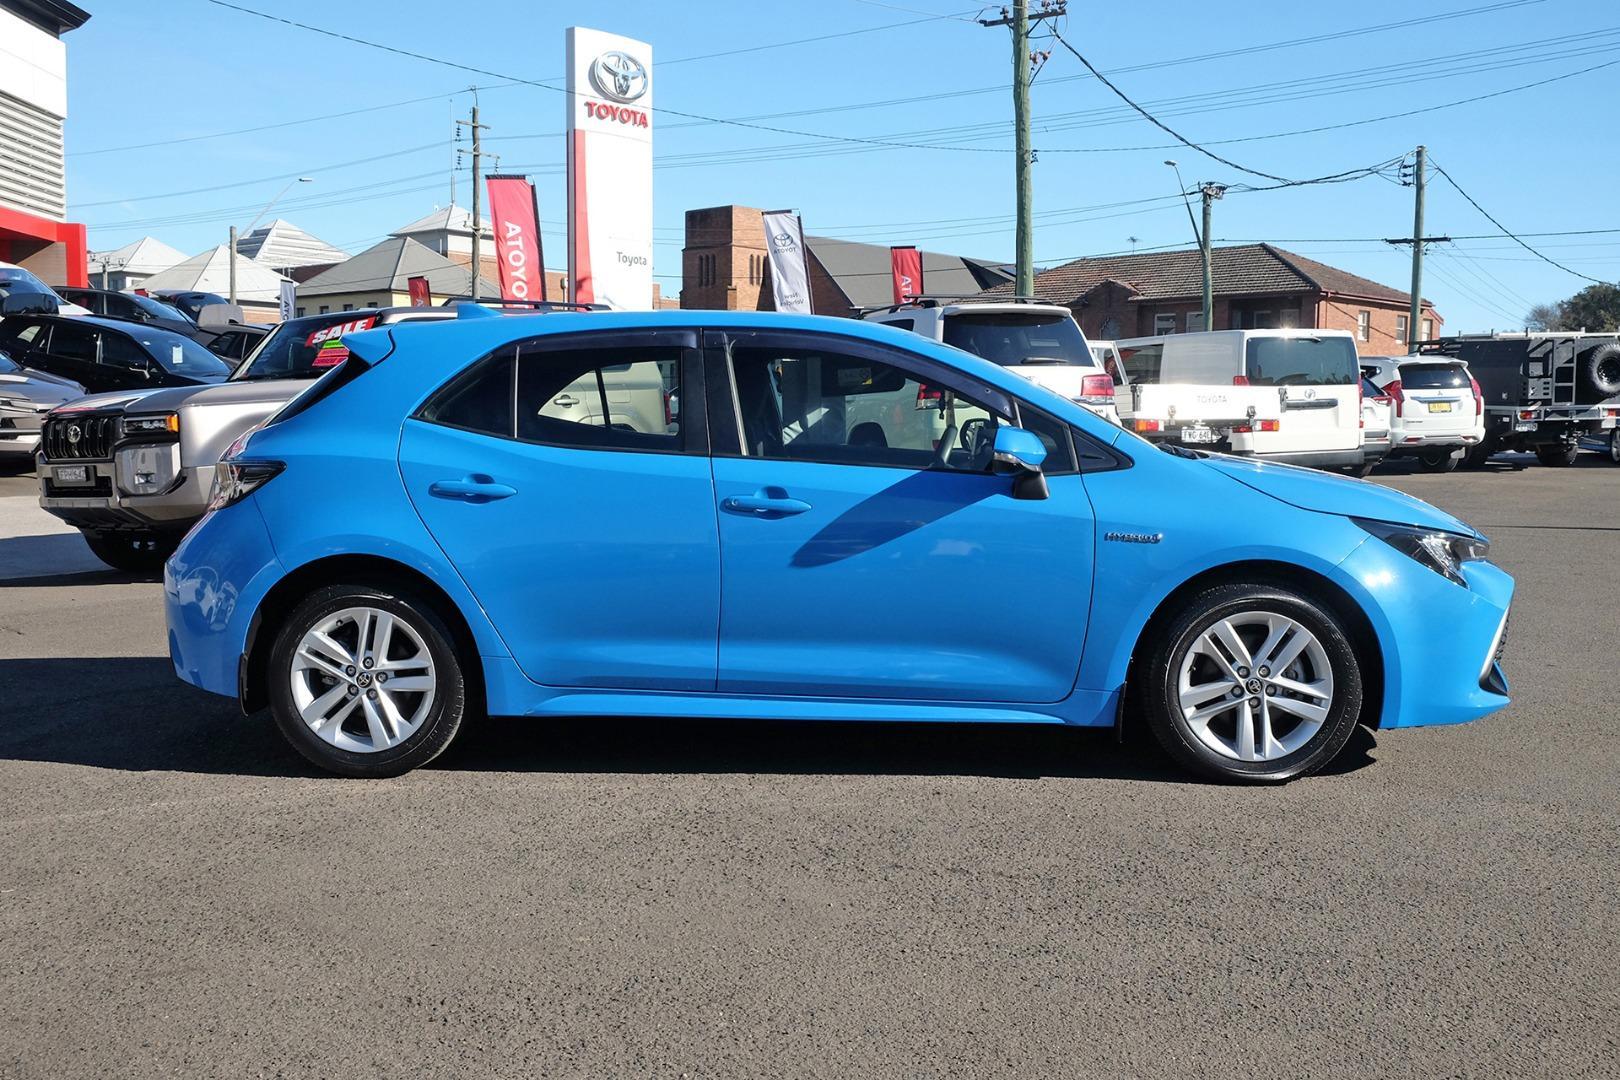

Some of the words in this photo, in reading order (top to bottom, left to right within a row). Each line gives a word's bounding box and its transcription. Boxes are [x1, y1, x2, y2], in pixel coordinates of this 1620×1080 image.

[584, 101, 648, 128] TOYOTA
[616, 251, 647, 267] Toyota
[312, 319, 369, 343] SALE
[1197, 395, 1228, 404] TOYOTA
